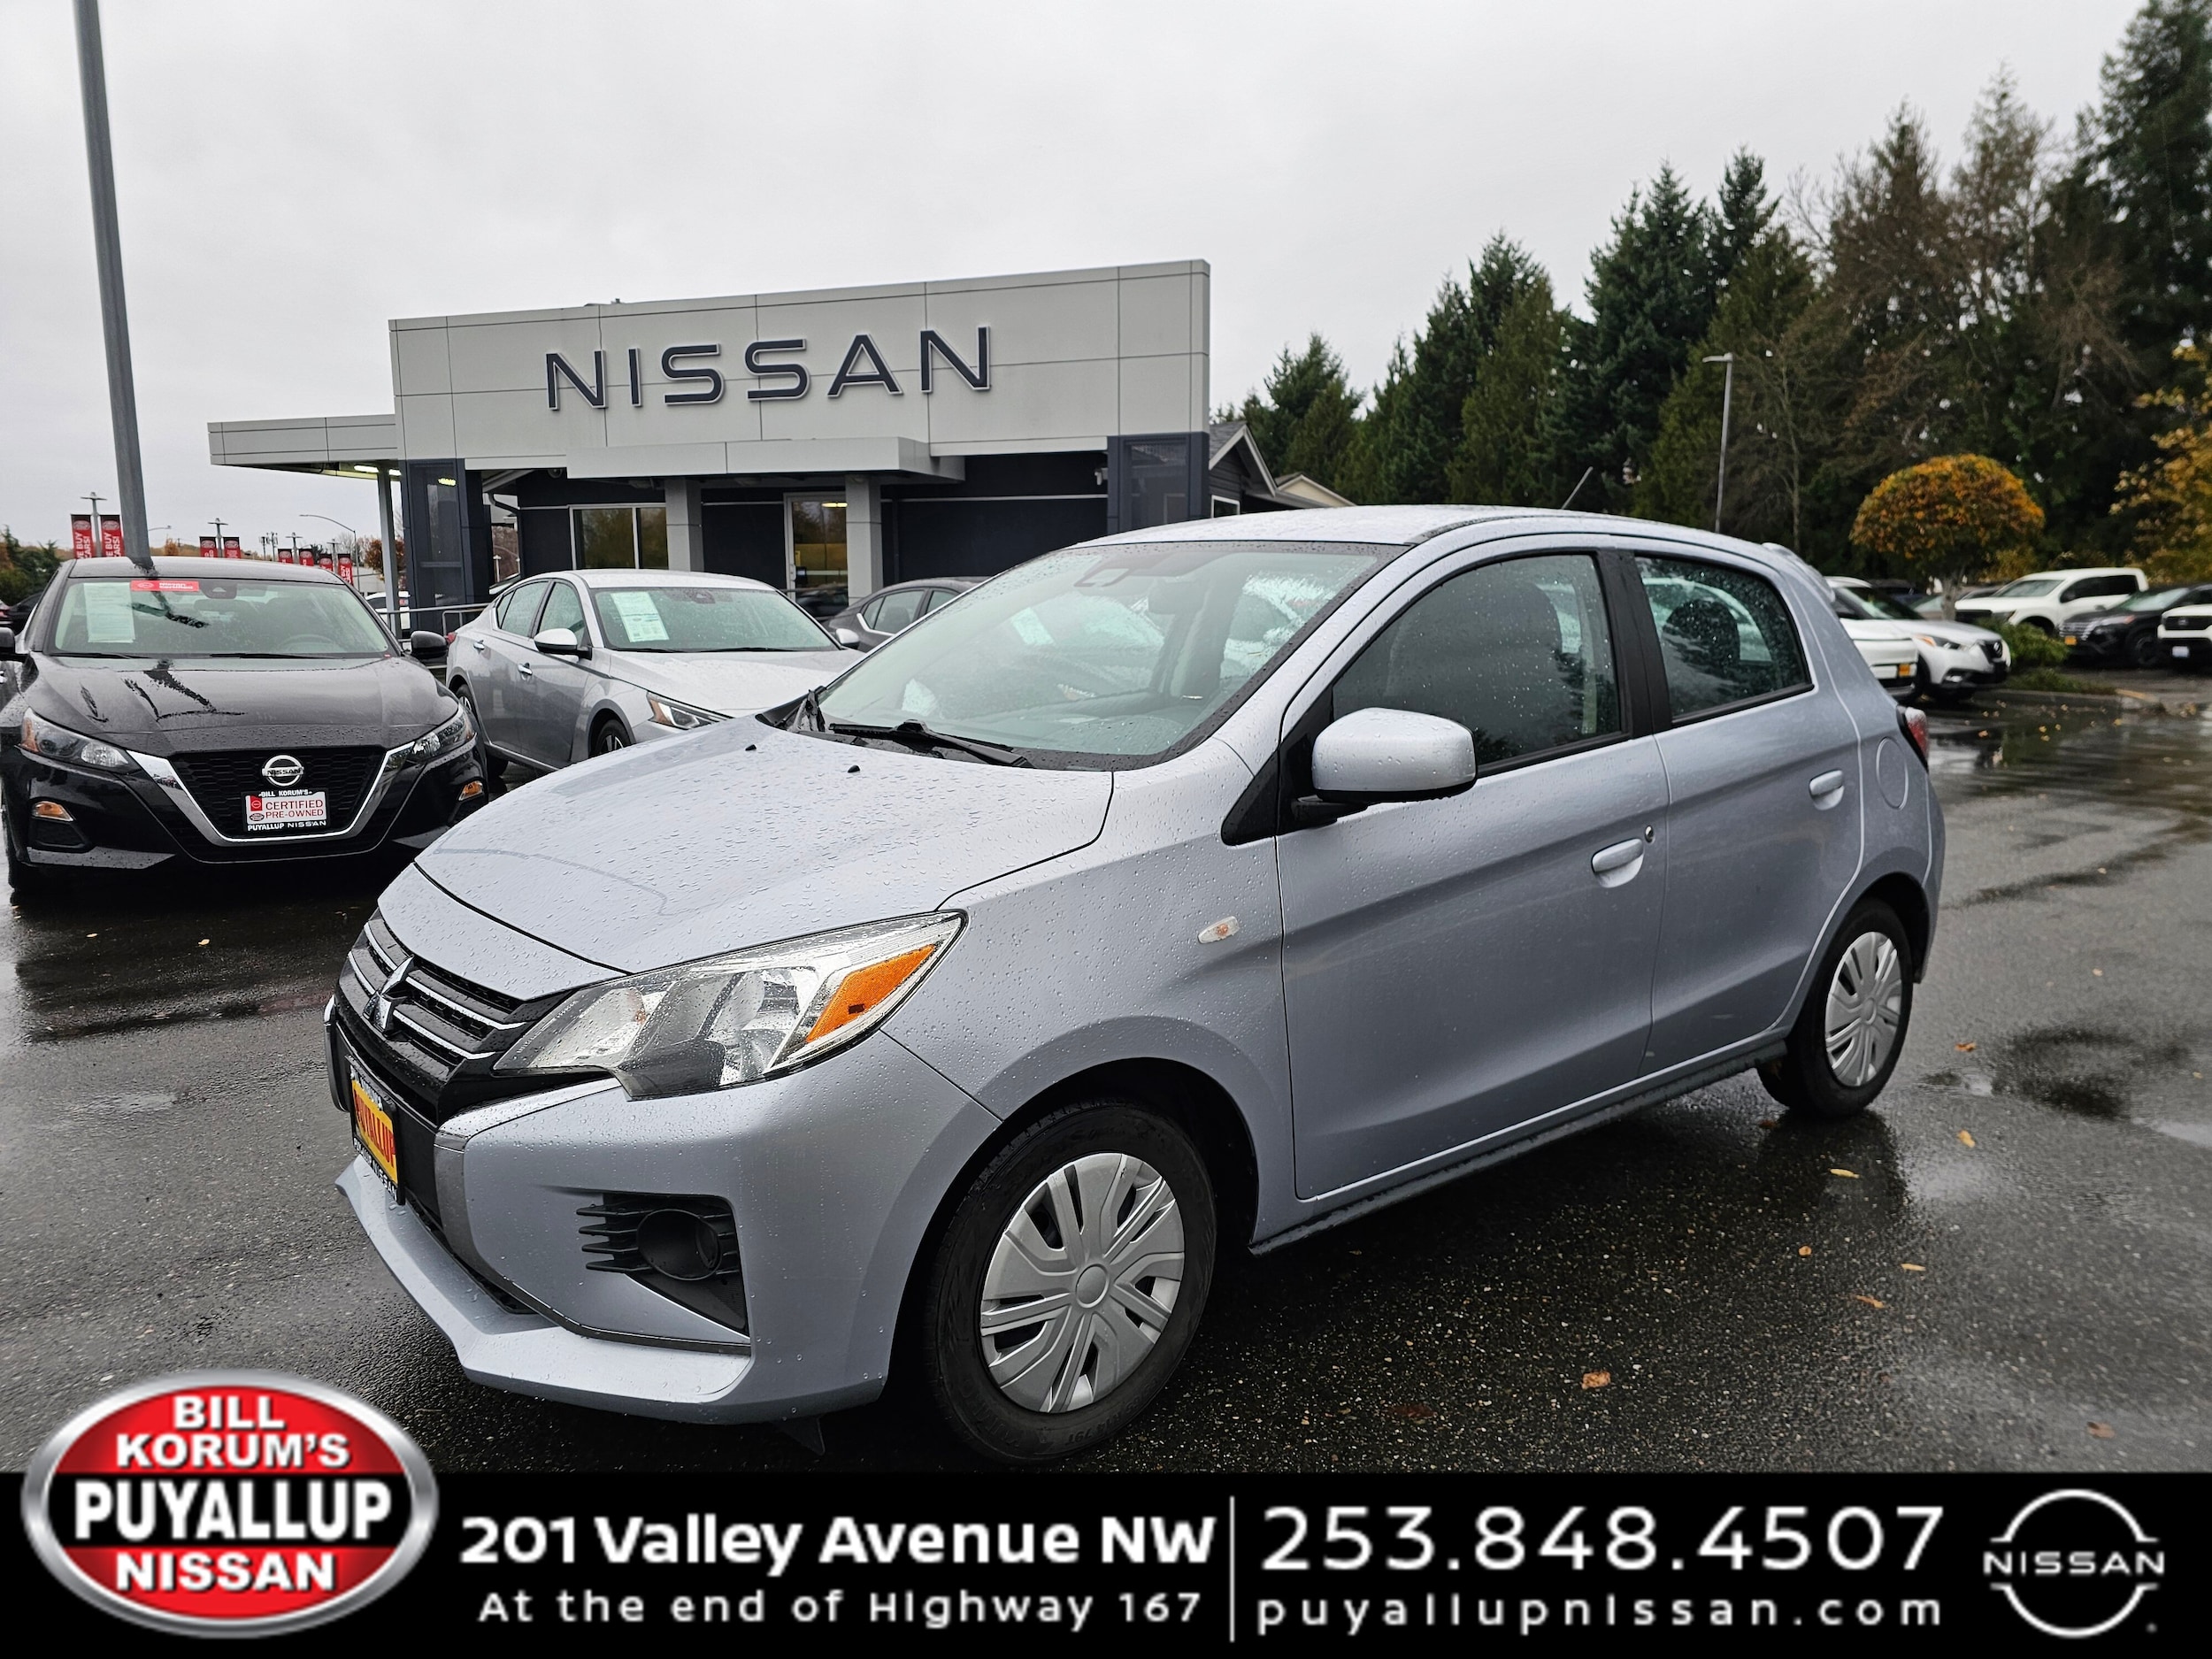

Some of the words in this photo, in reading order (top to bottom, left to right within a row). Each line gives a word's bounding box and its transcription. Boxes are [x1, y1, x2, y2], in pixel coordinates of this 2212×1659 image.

[545, 326, 991, 411] NISSAN
[74, 532, 84, 549] BUY
[104, 532, 113, 549] BUY
[112, 535, 122, 557] ARS!
[265, 799, 323, 810] CERTIFIED
[265, 809, 324, 818] PRE-OWNED
